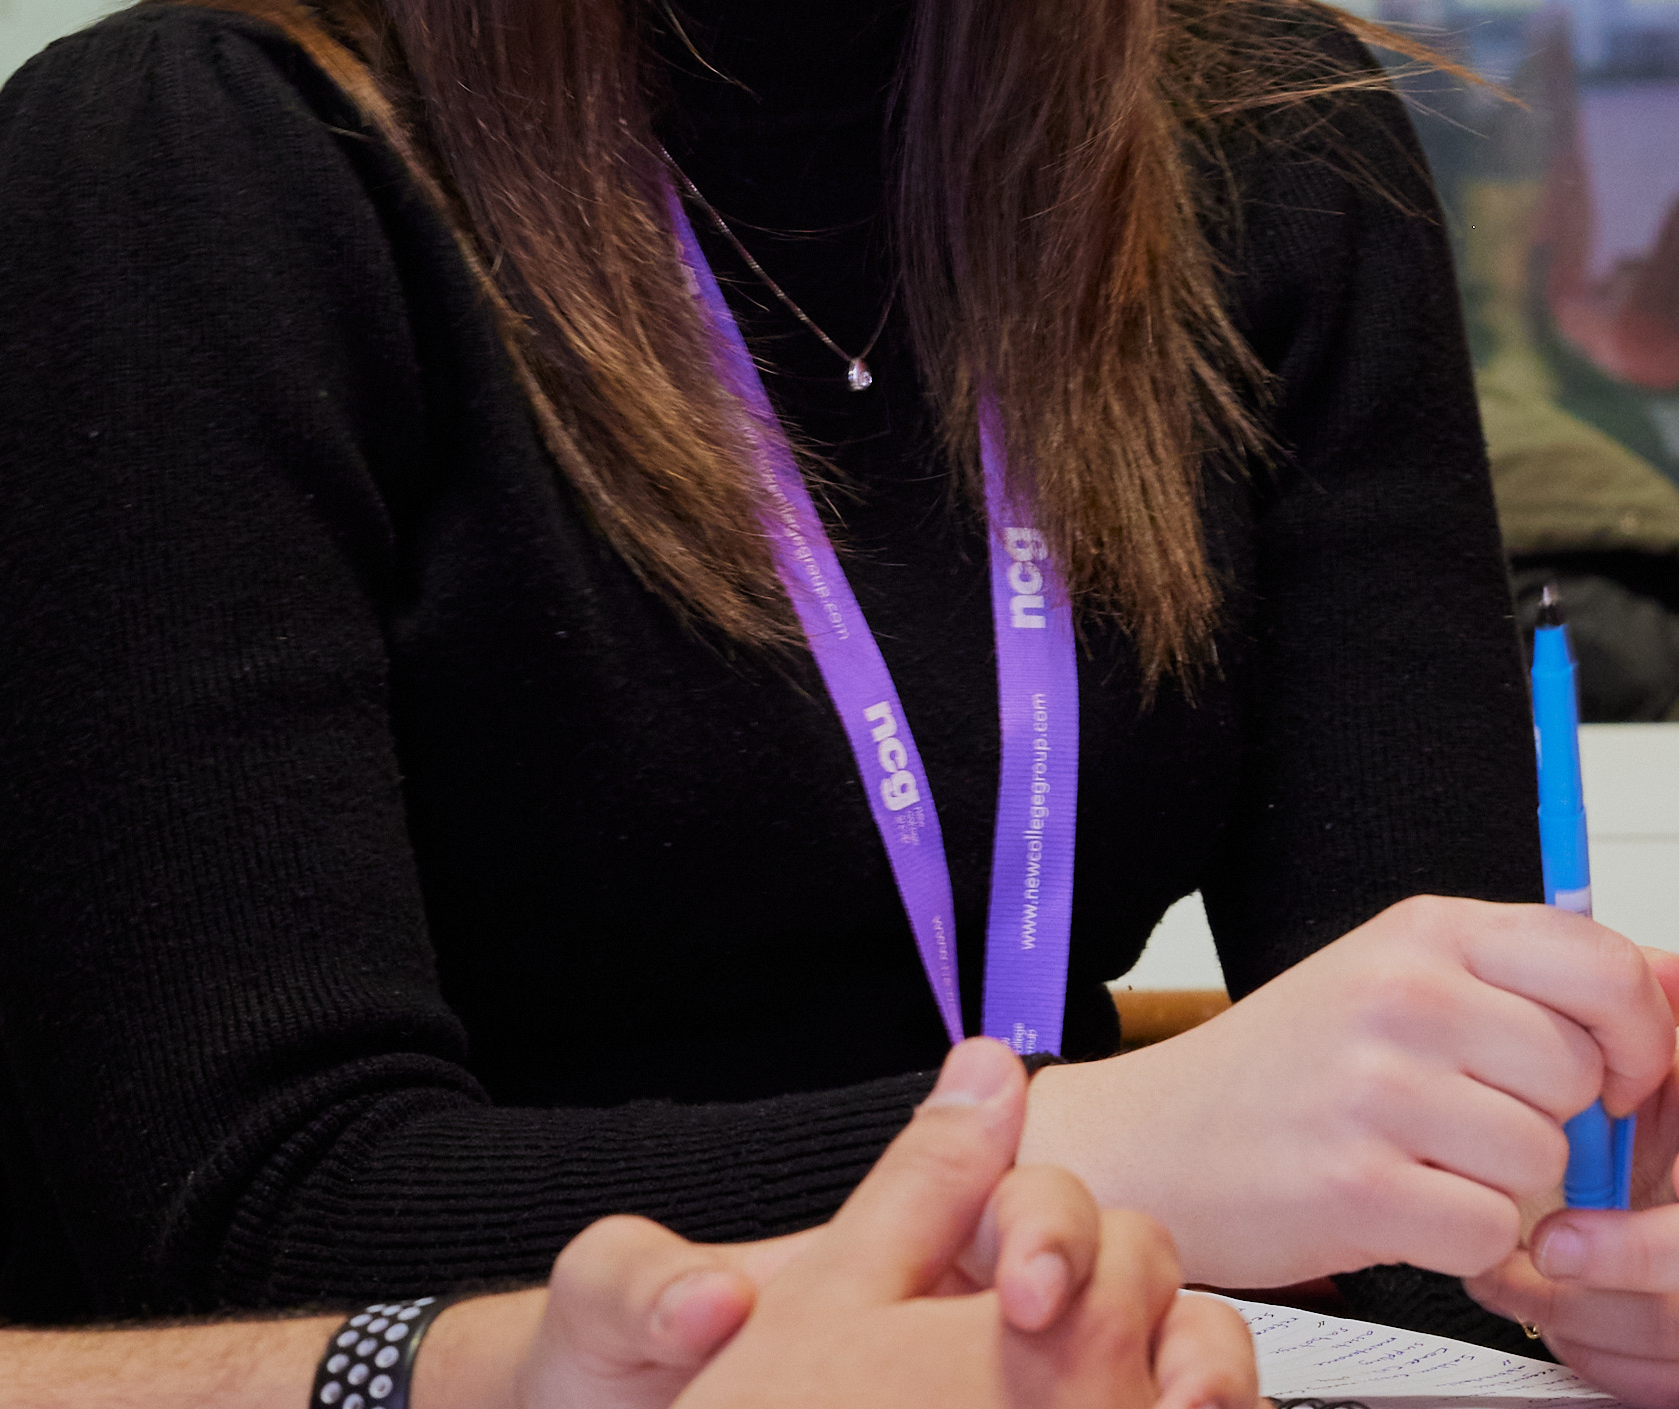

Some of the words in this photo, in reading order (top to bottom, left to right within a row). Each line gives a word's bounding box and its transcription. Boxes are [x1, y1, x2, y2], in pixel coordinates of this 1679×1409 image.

[1002, 526, 1049, 631] ncg
[863, 701, 920, 812] ncg
[1021, 692, 1050, 950] www.newcollegegroup.com
